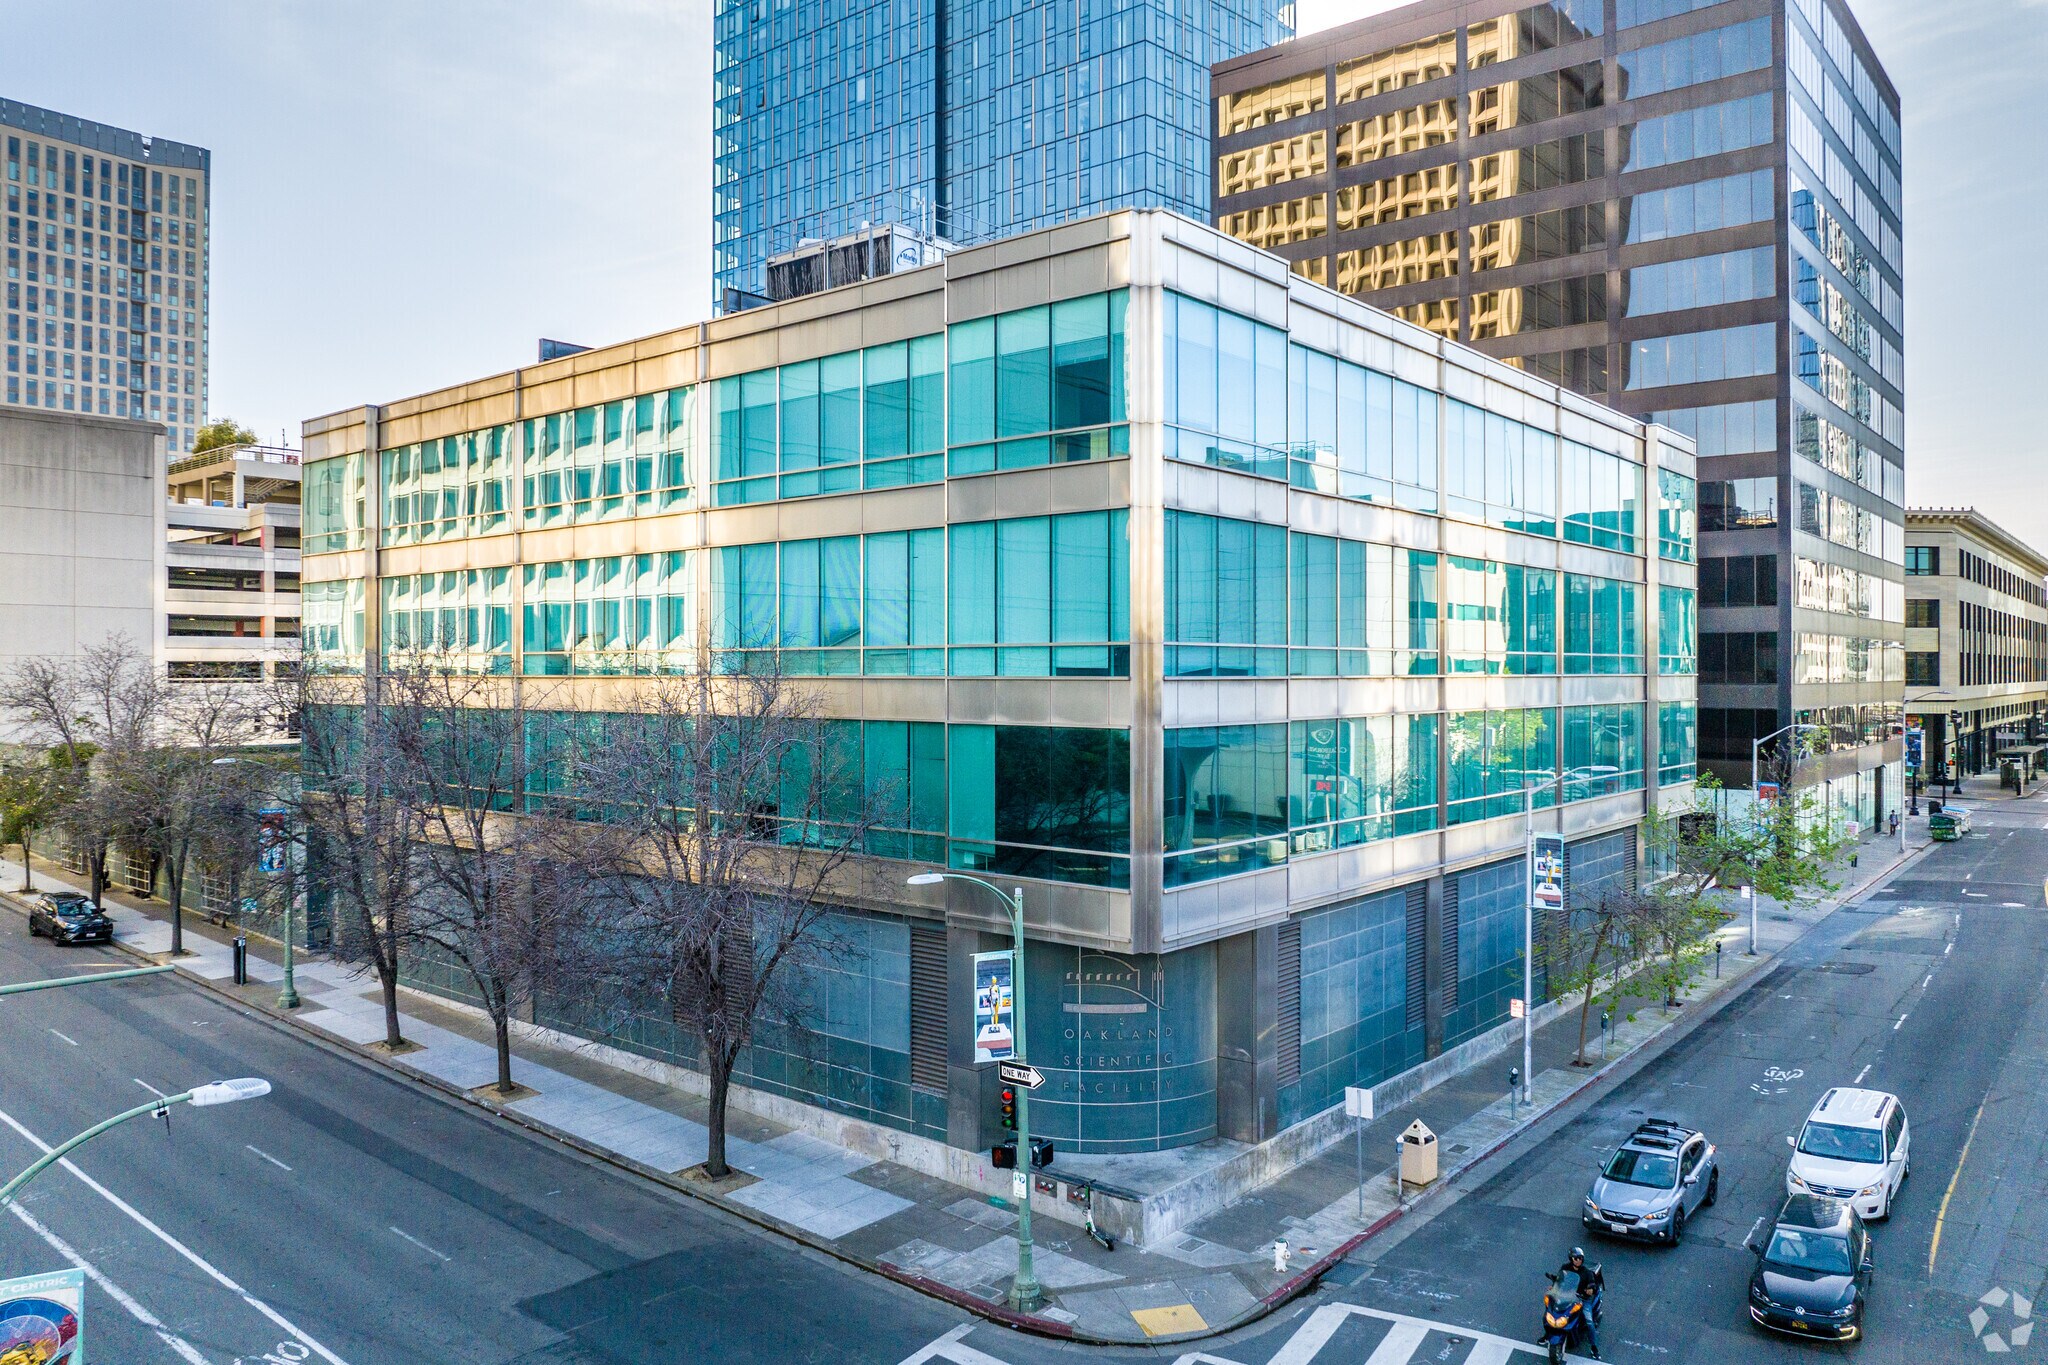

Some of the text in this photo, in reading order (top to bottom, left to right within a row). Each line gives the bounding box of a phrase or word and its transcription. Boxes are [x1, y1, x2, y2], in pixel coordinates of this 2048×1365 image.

[1064, 1027, 1173, 1040] OAKLAND
[1063, 1053, 1172, 1067] SCIENTIFC
[1003, 1067, 1030, 1080] ONE WAY
[1063, 1080, 1172, 1093] FACILITY
[10, 1276, 69, 1293] CENTRIC
